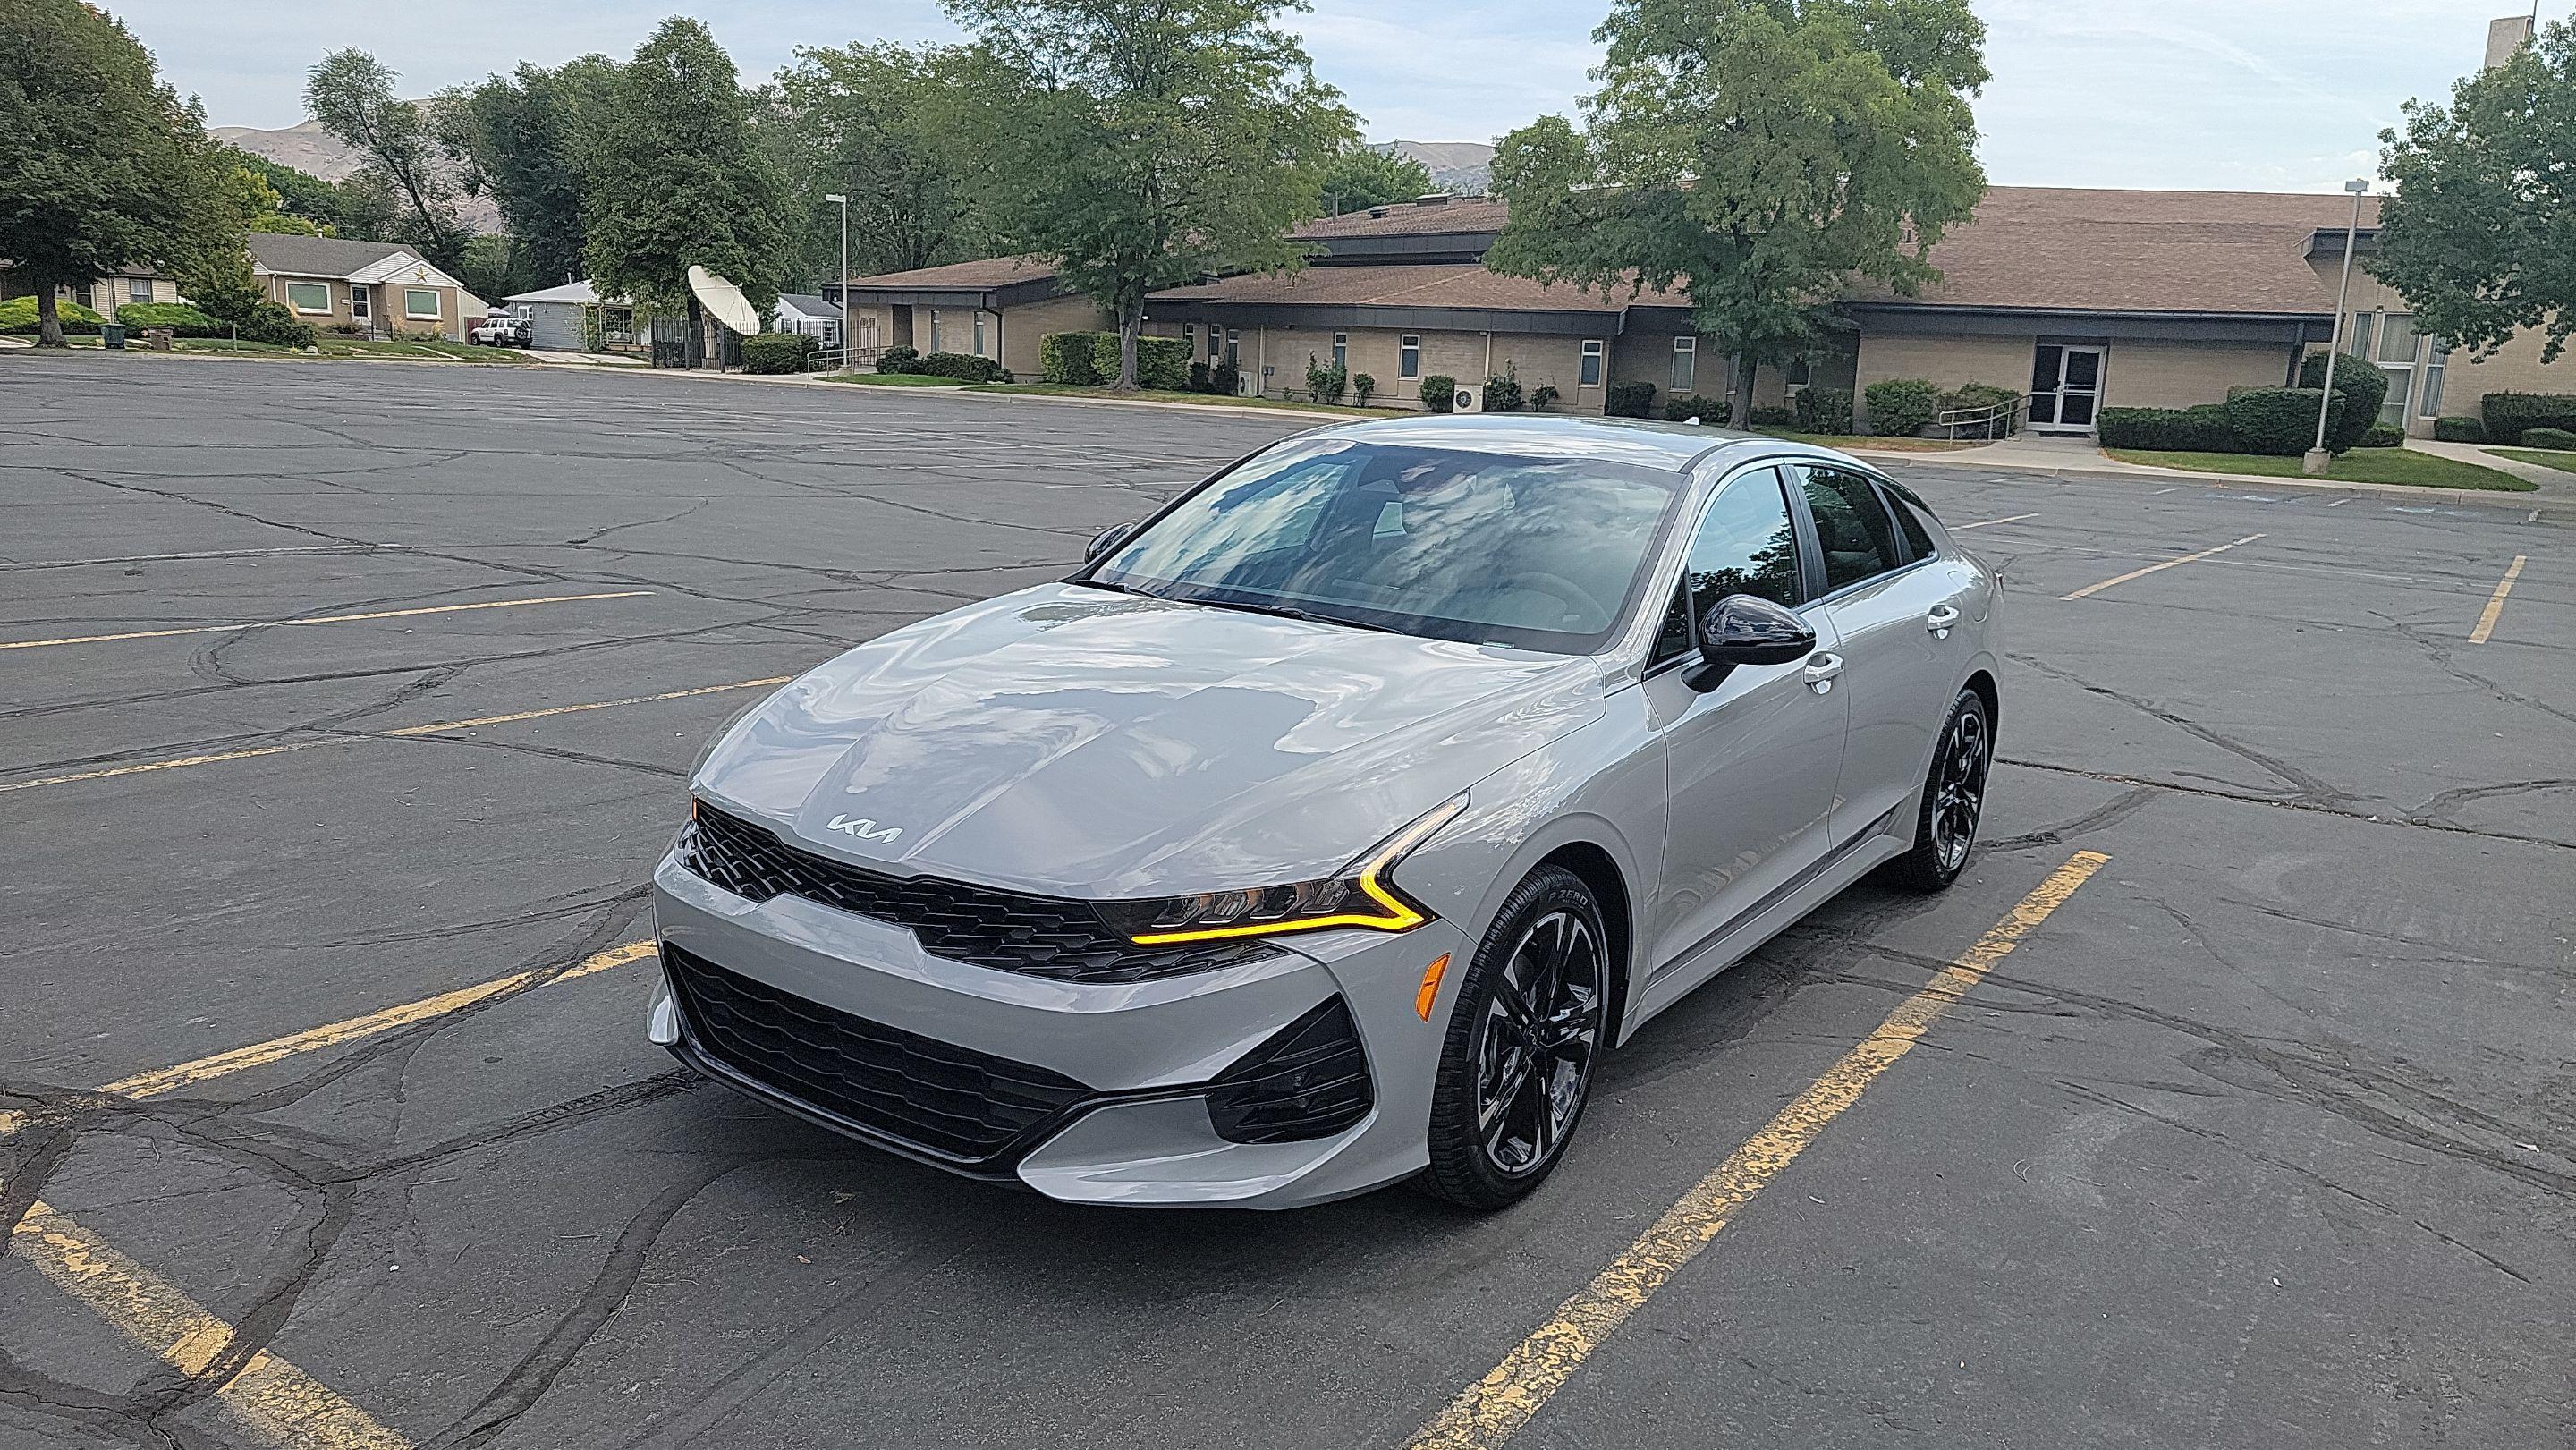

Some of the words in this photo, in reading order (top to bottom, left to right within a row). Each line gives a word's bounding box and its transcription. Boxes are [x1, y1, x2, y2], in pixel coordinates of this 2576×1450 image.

[826, 813, 904, 844] KIA
[1548, 891, 1557, 903] P
[1558, 889, 1589, 906] ZERO
